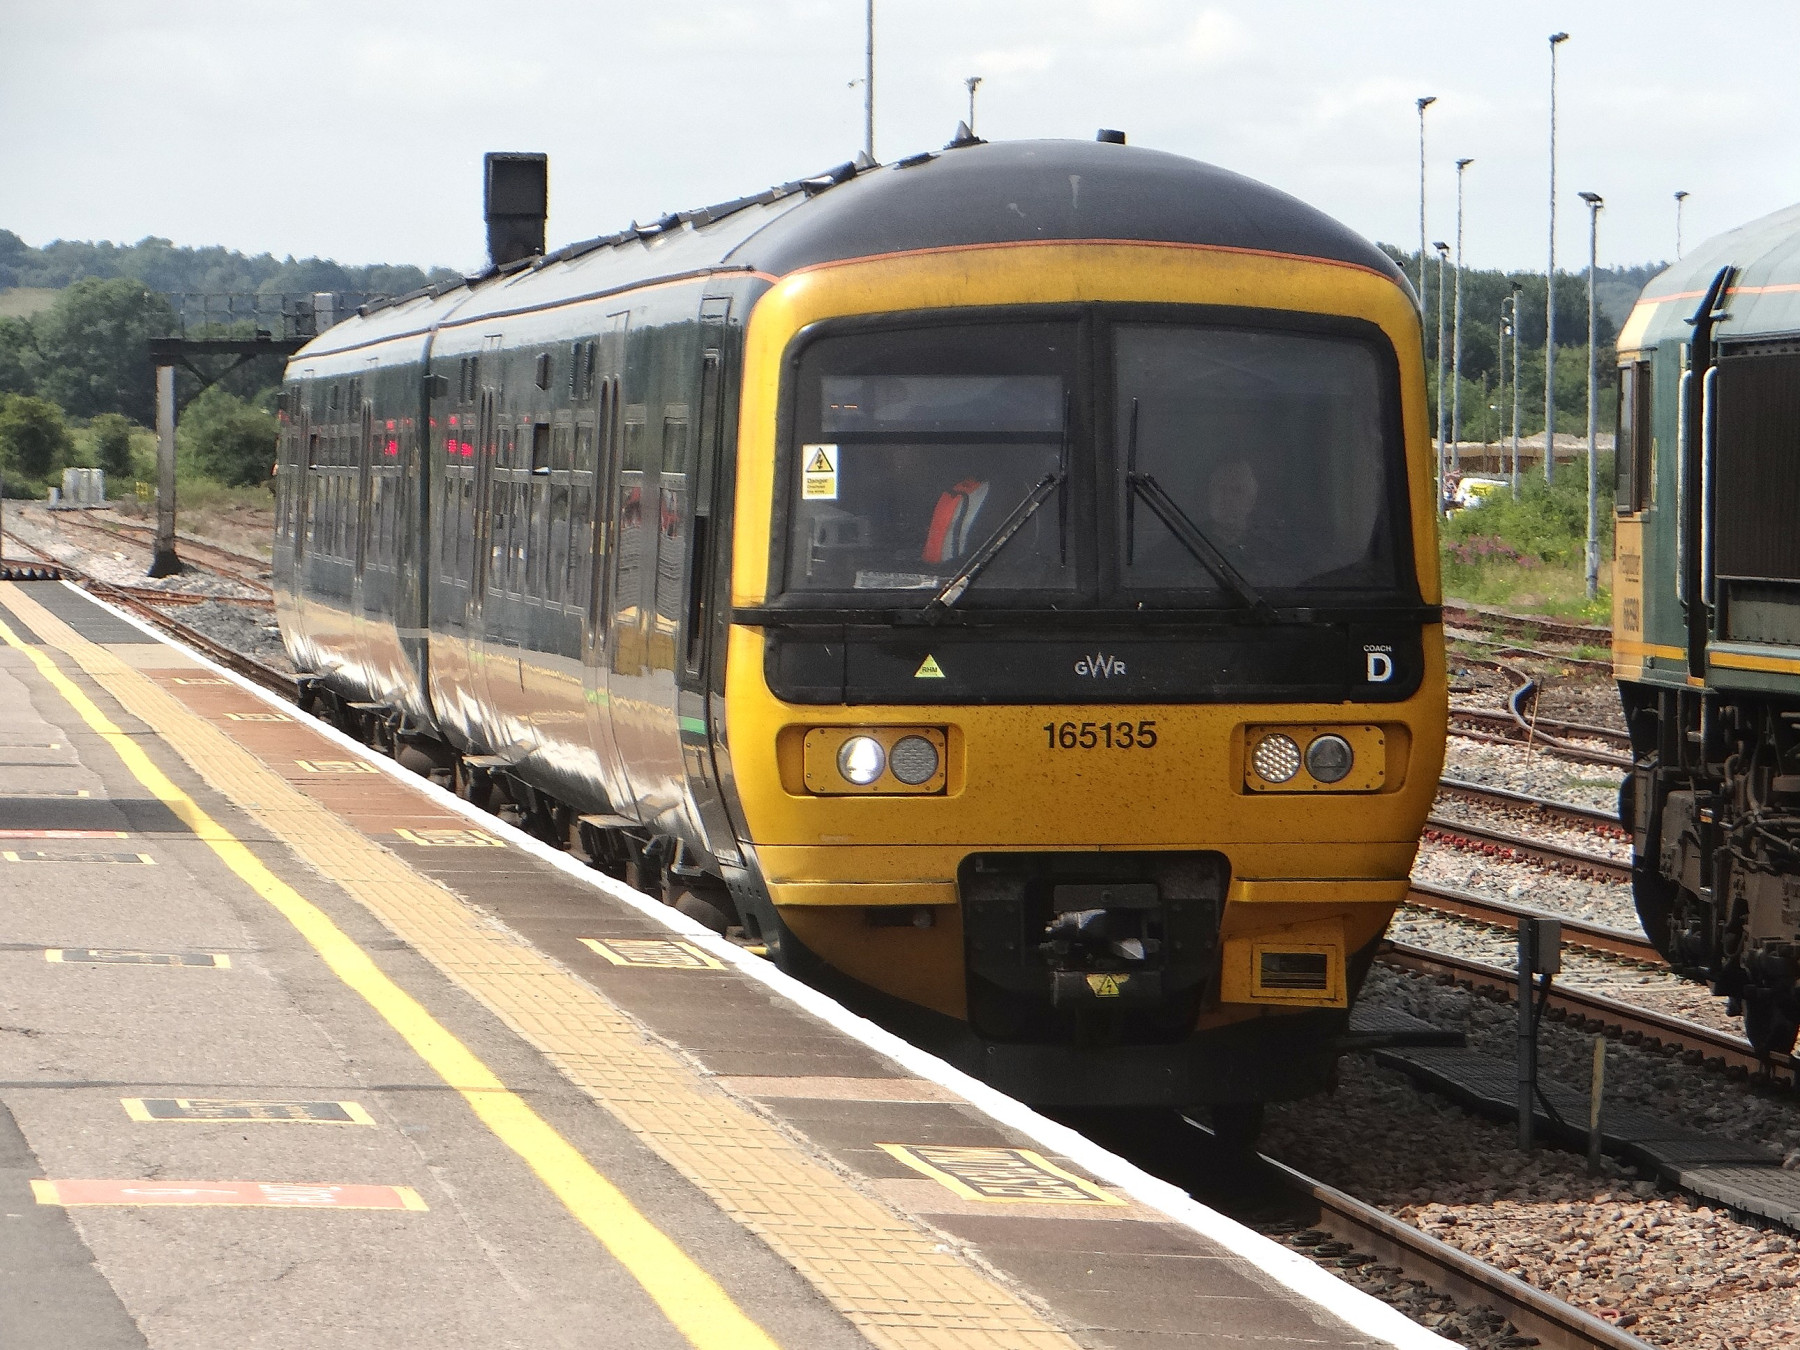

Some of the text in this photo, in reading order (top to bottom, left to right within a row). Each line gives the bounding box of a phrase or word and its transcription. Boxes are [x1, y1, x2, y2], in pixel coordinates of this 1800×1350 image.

[1363, 644, 1392, 652] COACH
[1074, 651, 1127, 679] GWR
[1366, 652, 1393, 682] D
[1043, 720, 1157, 749] 165135
